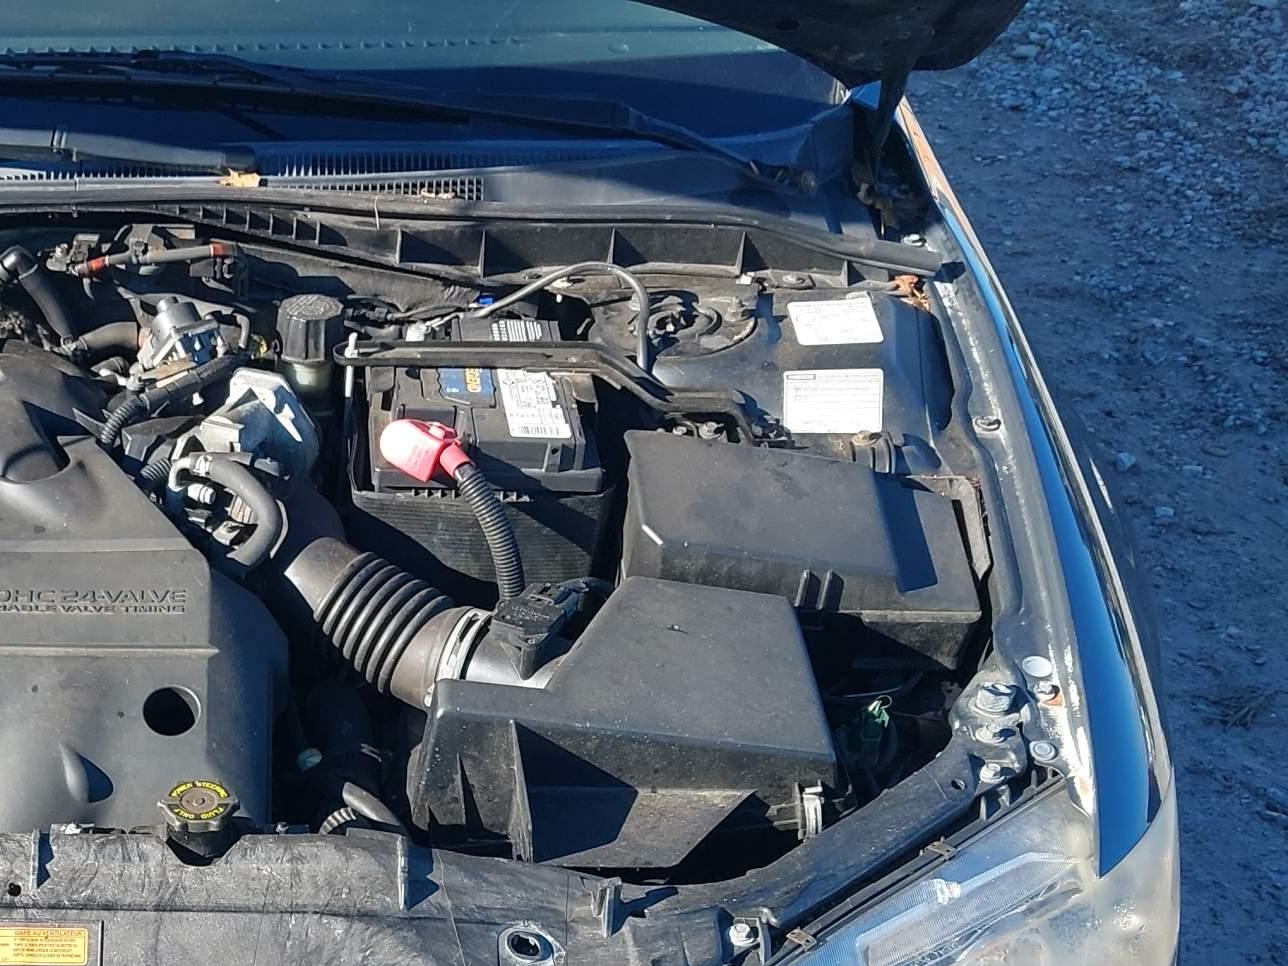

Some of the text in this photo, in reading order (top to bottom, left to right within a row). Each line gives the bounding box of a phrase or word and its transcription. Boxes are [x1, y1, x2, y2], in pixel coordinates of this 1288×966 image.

[60, 589, 187, 603] 24-VALVE
[60, 604, 116, 613] VALVE
[121, 604, 186, 613] TIMING
[173, 808, 195, 819] ONLY
